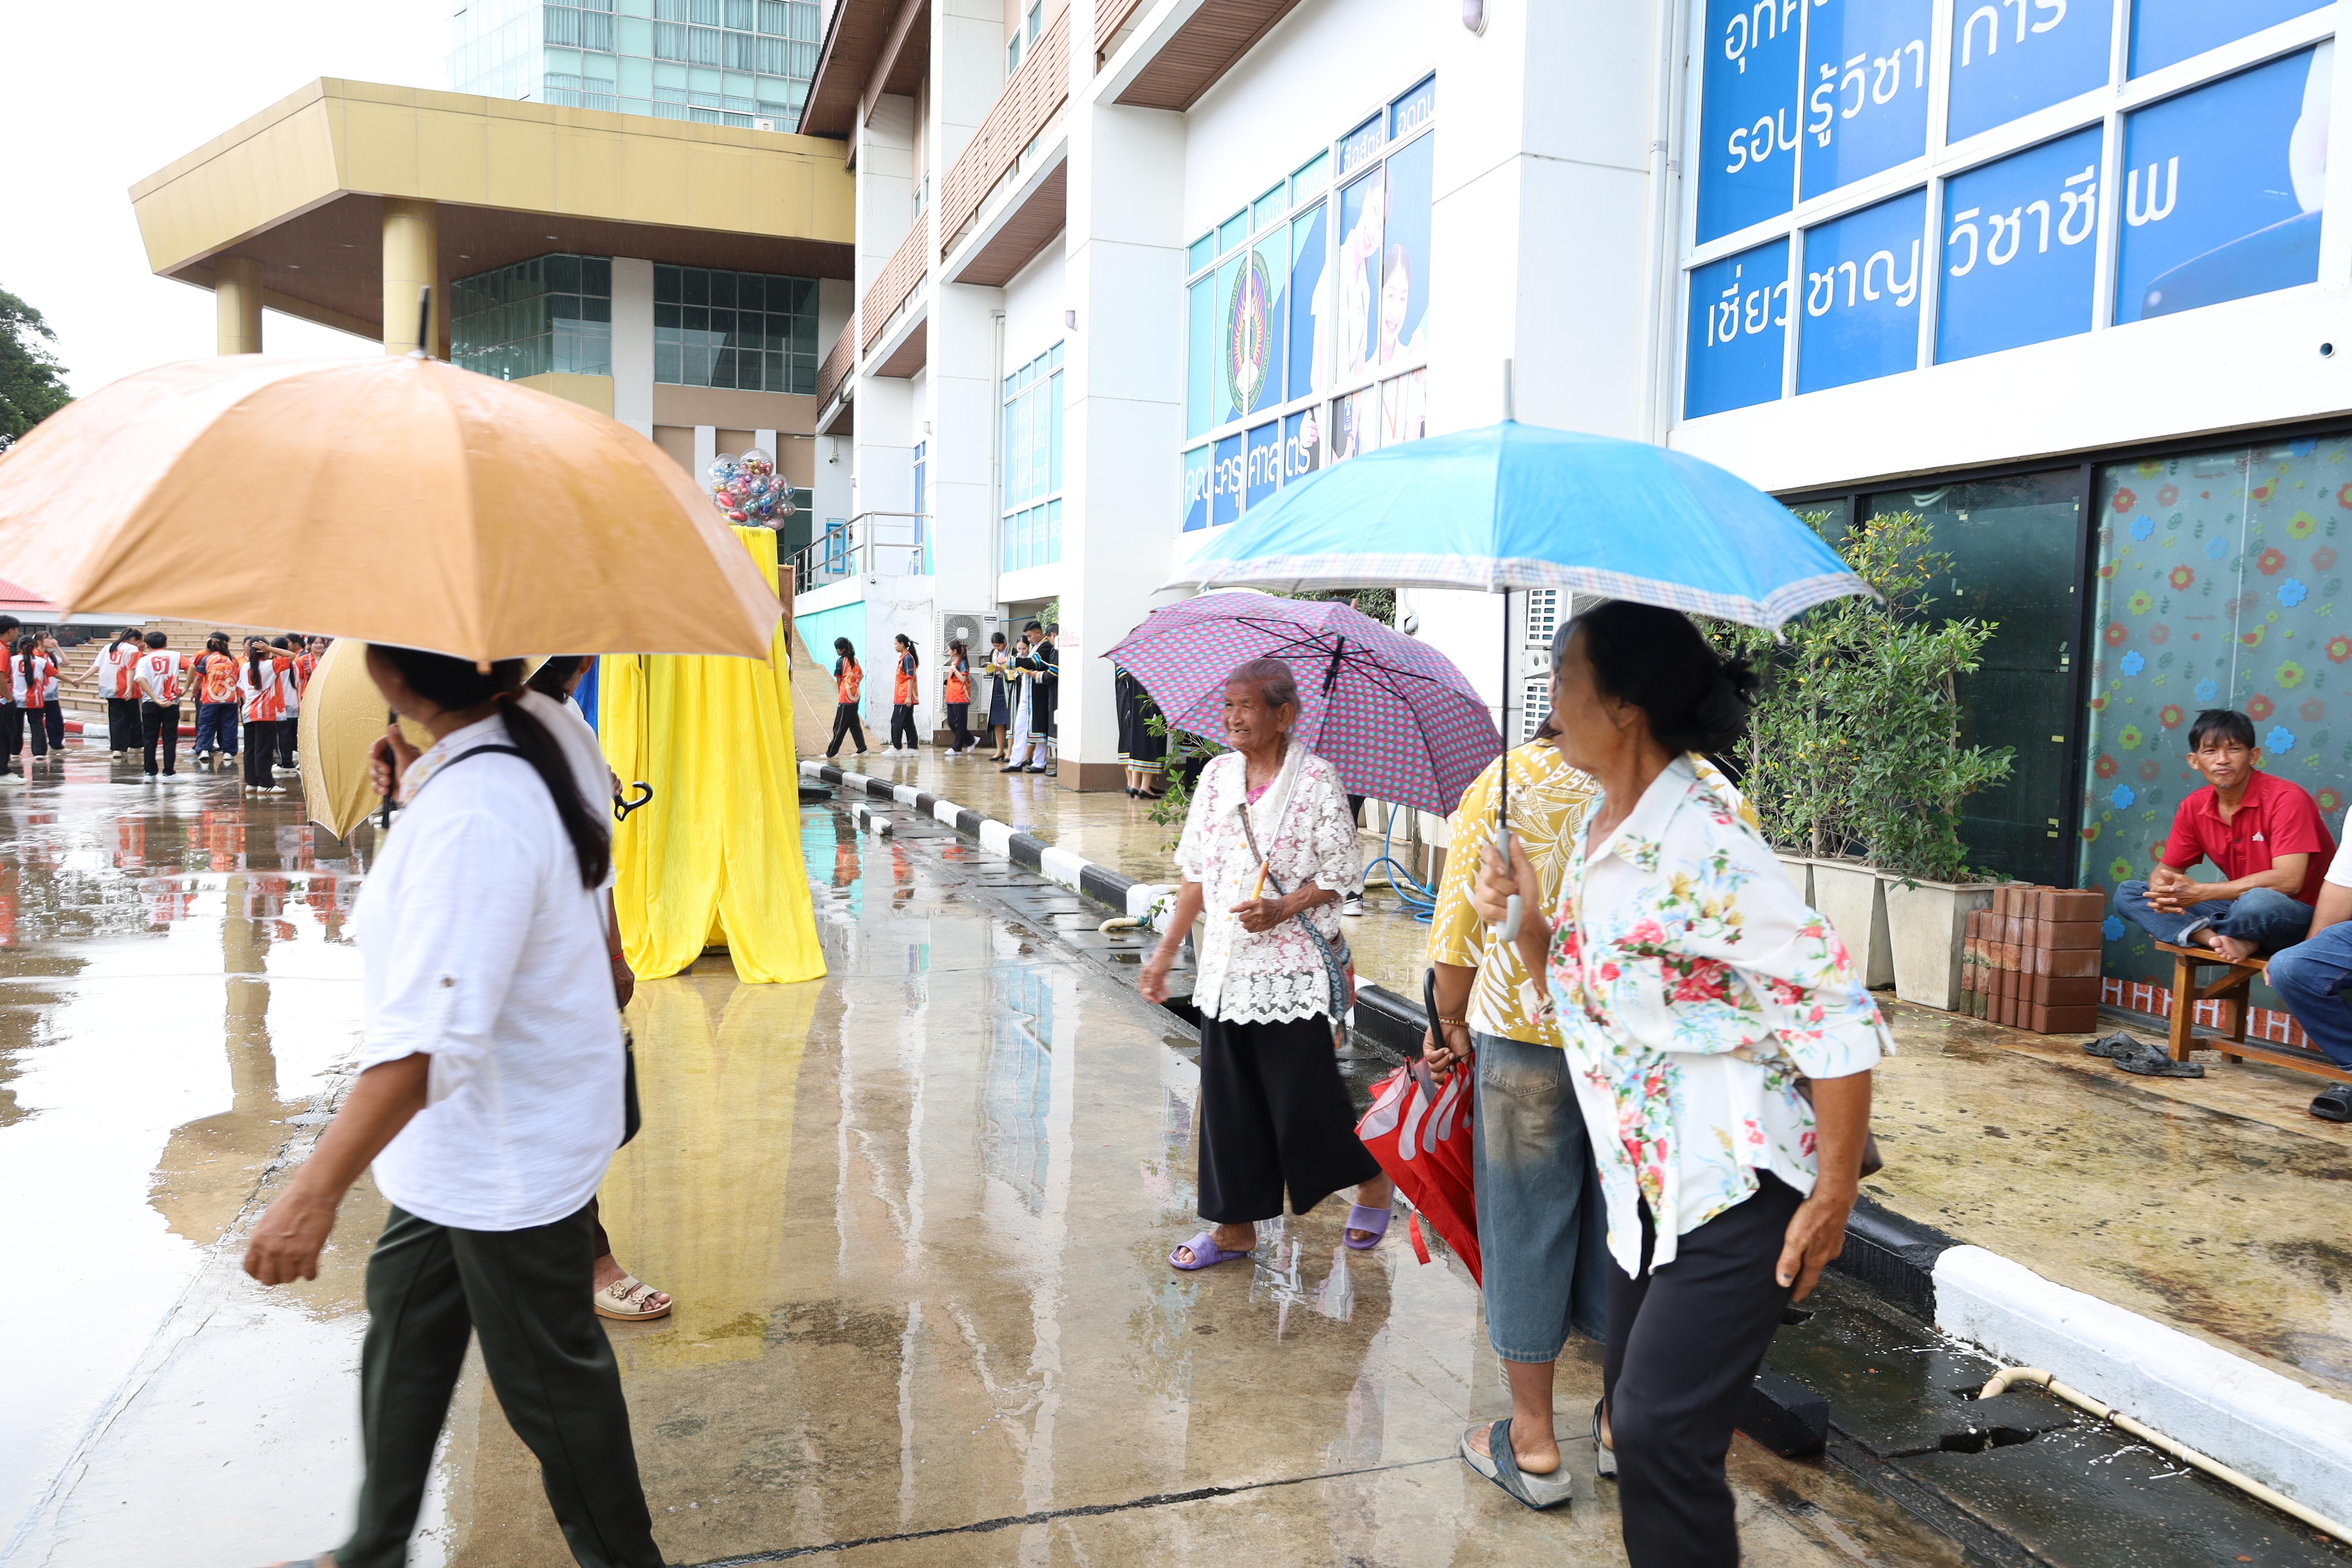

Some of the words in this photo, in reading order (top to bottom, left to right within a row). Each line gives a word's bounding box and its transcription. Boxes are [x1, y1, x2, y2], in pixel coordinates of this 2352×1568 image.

[1184, 435, 1311, 508] คณะครุศาสตร
[151, 656, 170, 674] 67
